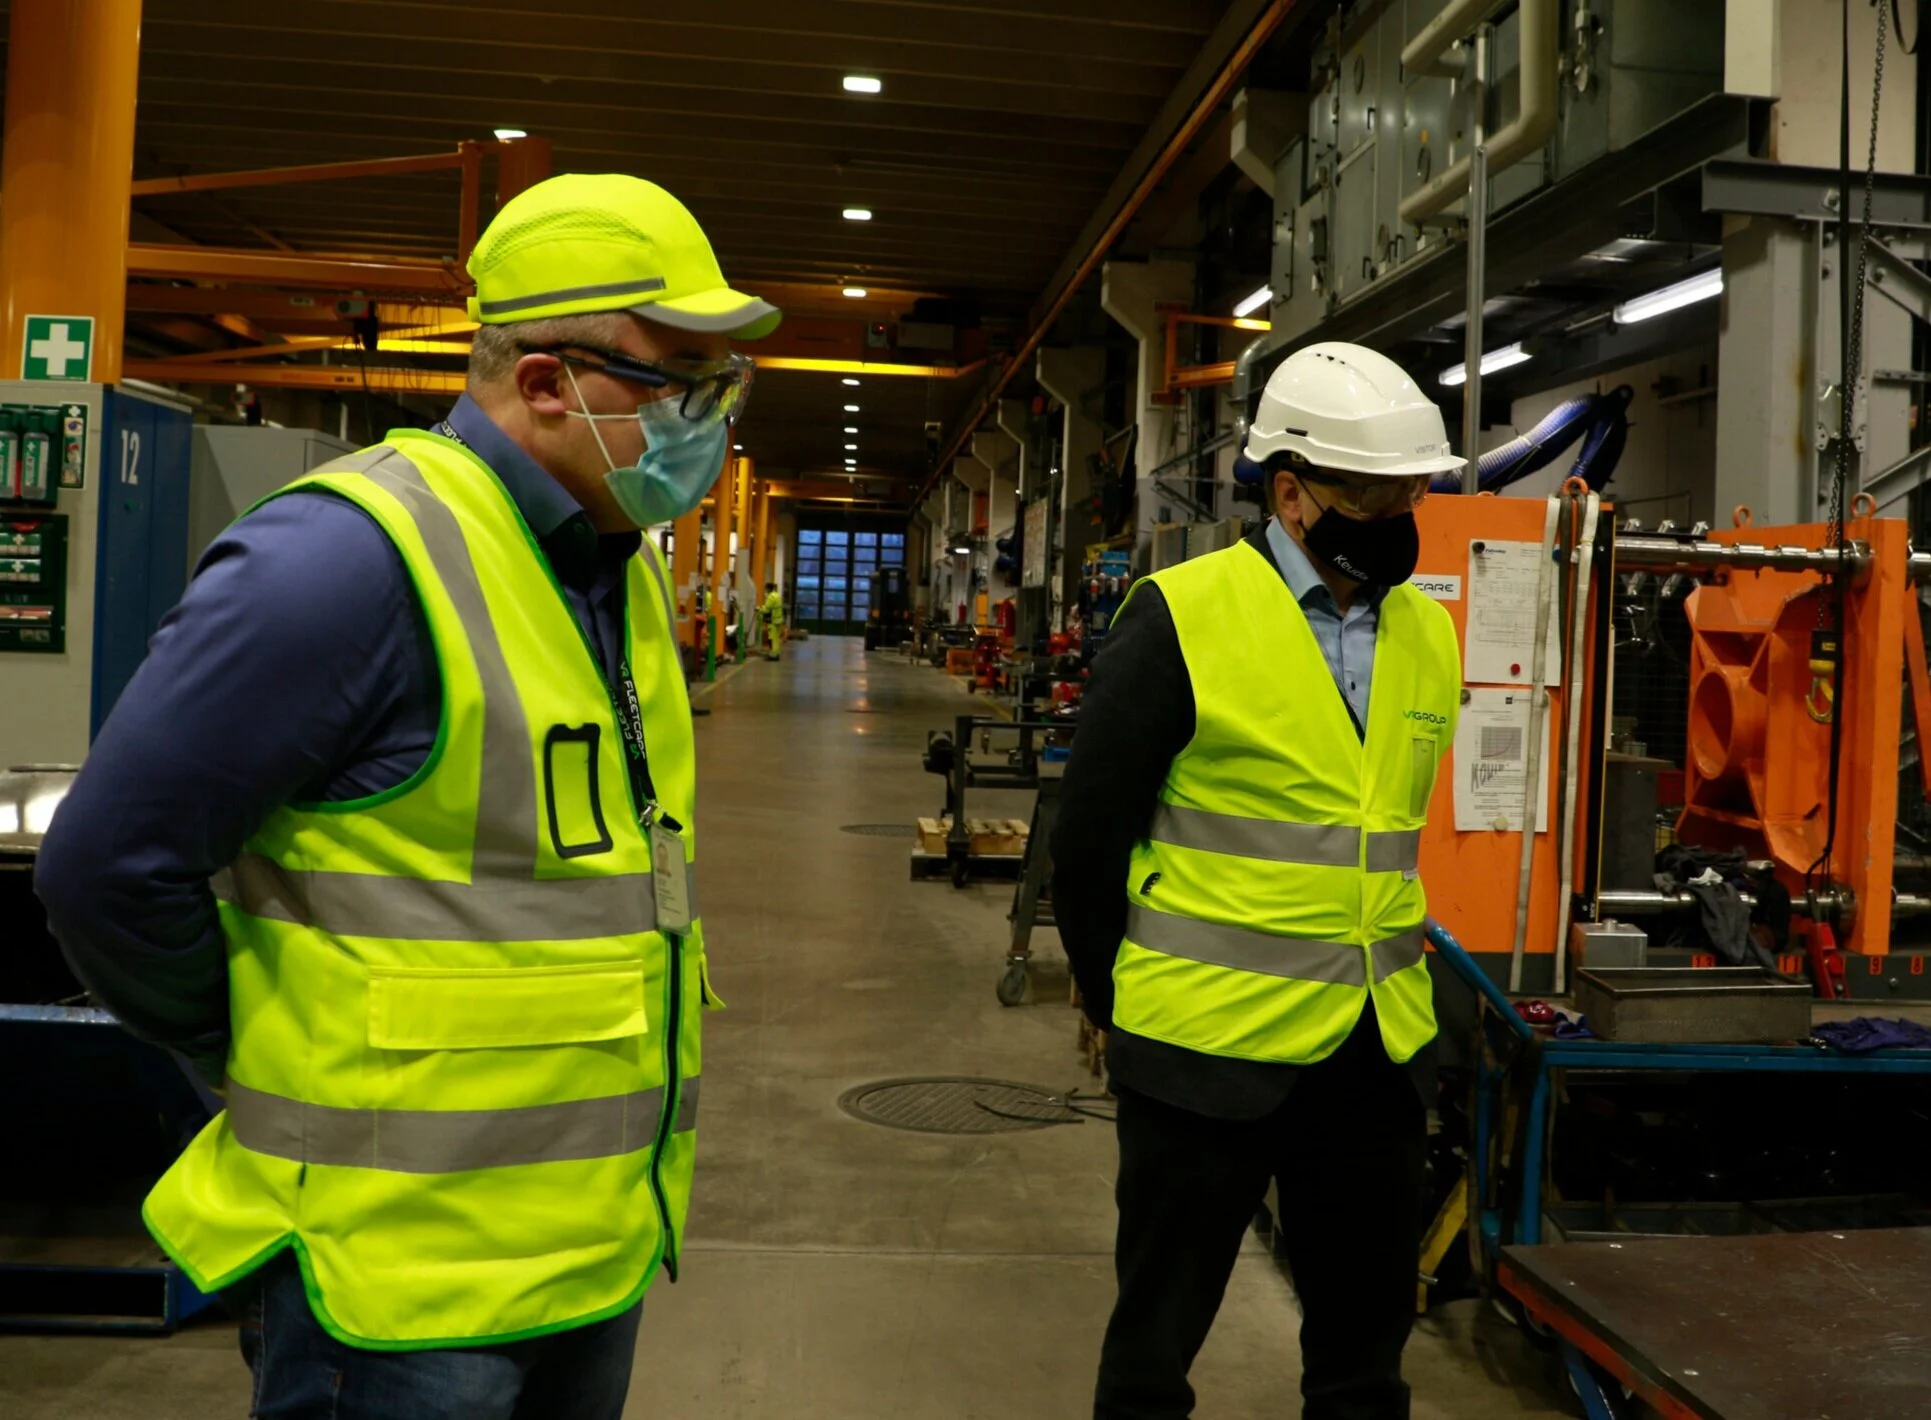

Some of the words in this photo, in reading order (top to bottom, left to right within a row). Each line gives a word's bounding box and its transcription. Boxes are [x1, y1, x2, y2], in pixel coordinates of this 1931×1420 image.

[121, 429, 140, 485] 12
[1333, 553, 1369, 581] Keuda
[1410, 582, 1454, 593] CARE
